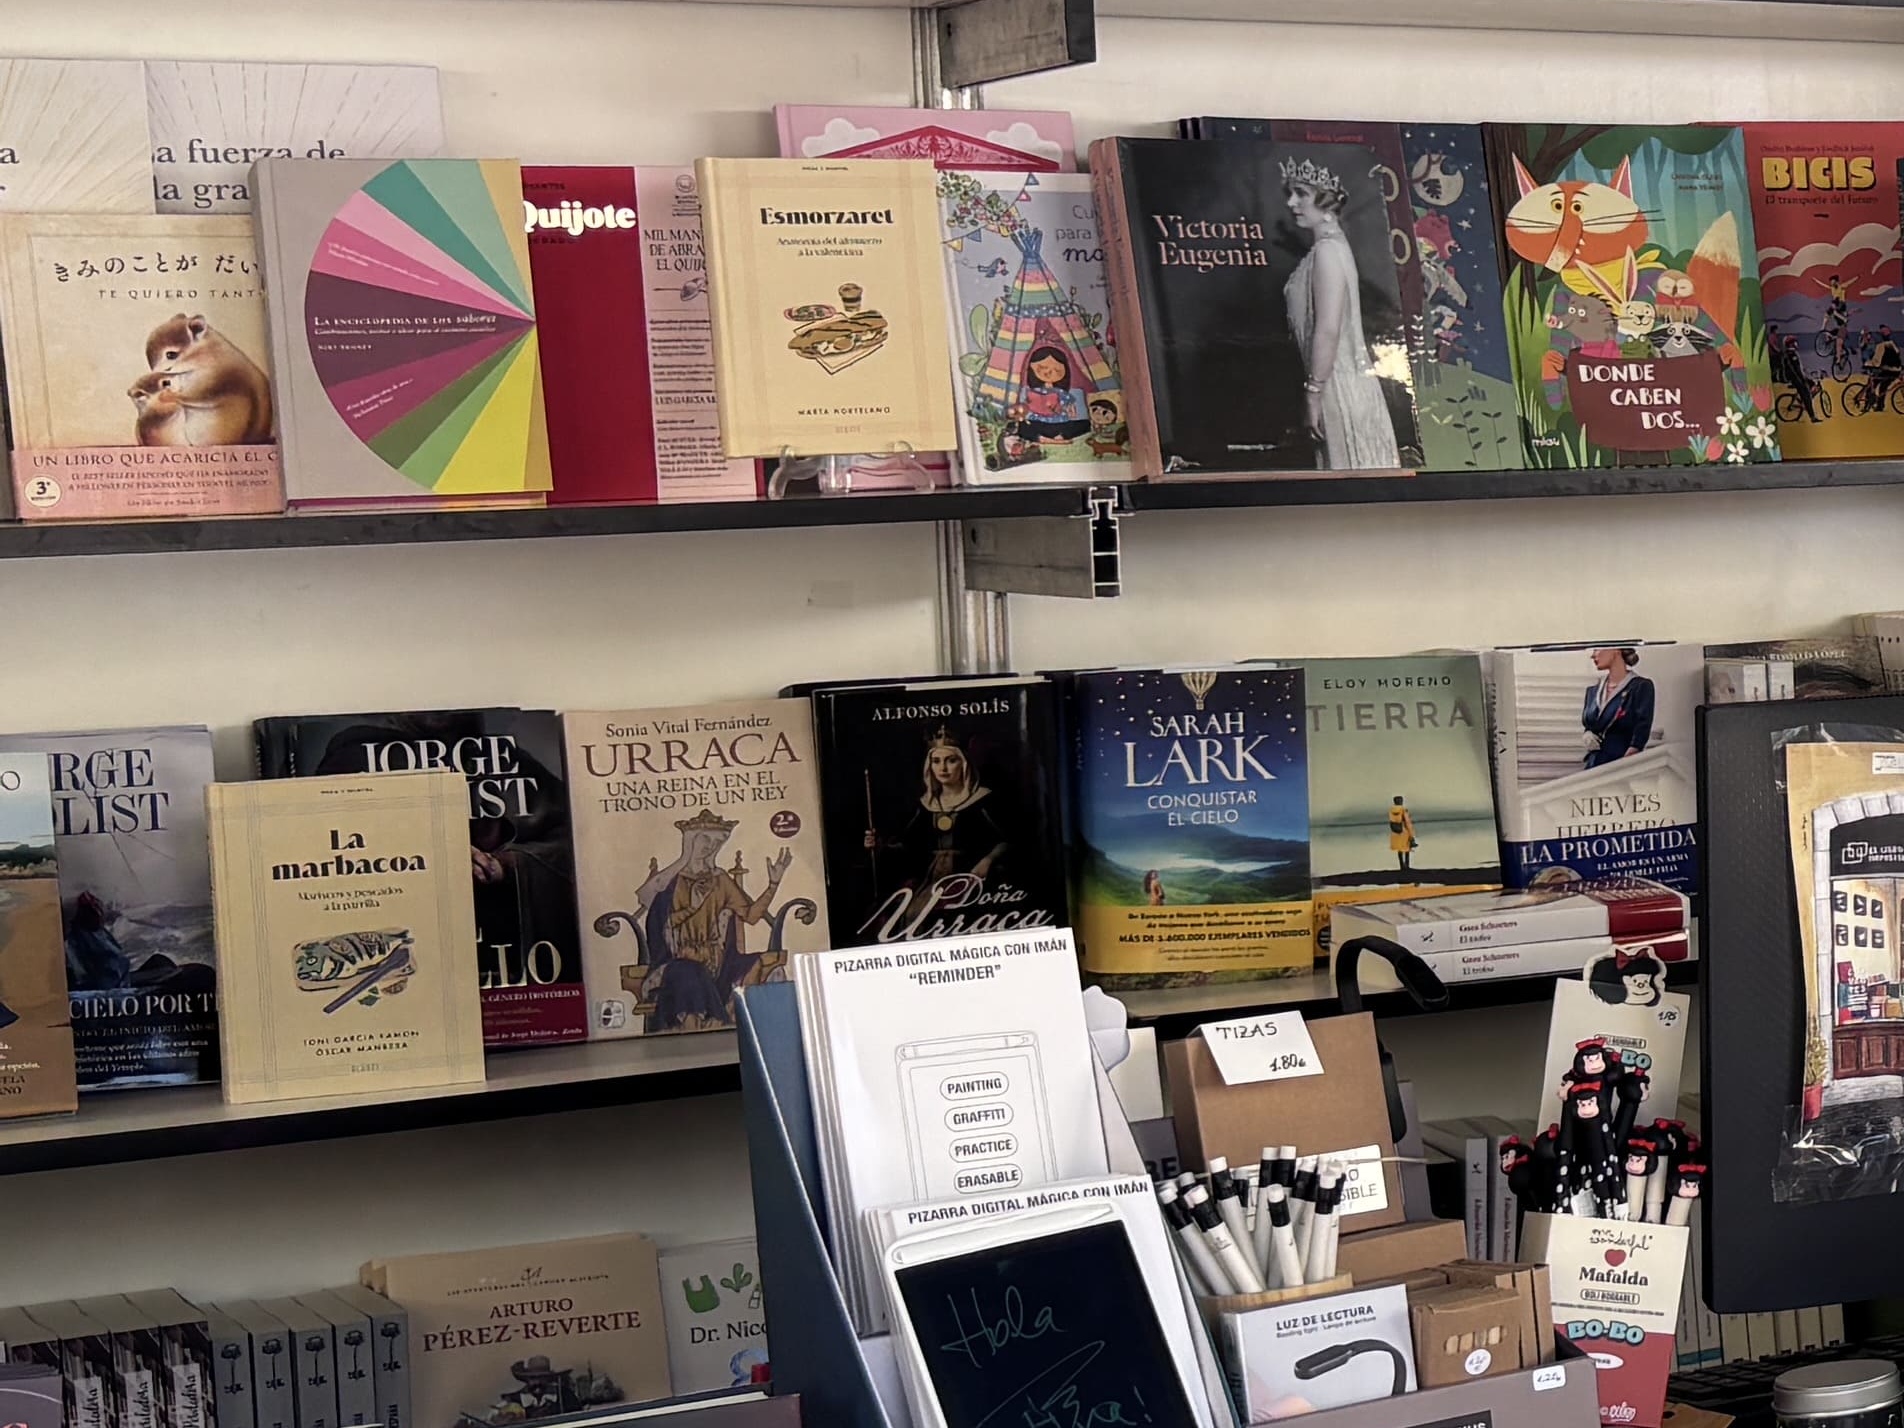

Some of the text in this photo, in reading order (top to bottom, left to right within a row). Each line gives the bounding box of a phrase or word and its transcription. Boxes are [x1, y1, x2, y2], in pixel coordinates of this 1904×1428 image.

[1762, 157, 1876, 191] BICIS
[760, 206, 894, 226] Esmorzaret
[1153, 215, 1264, 240] Victoria
[1159, 240, 1268, 271] Eugenia
[1579, 362, 1655, 384] DONDE
[1610, 386, 1681, 406] CABEN
[1641, 409, 1701, 430] DOS...
[1323, 675, 1452, 690] ELOY MORENO
[871, 698, 1010, 722] ALFONSO SOLÍS
[1308, 702, 1476, 733] TIERRA
[606, 714, 772, 738] Sonia Vital Fernández
[1150, 712, 1245, 739] SARAH
[581, 733, 802, 778] URRACA
[1124, 734, 1279, 788] LARK
[1148, 791, 1257, 810] CONQUISTAR
[1167, 808, 1239, 827] EL CIELO
[329, 830, 365, 851] La
[1520, 827, 1697, 865] LA PROMETIDA
[272, 851, 426, 881] marbacoa
[834, 935, 1067, 974] PIZARRA DIGITAL MÁGICA CON IMÁN
[908, 964, 1003, 986] “REMINDER”
[1216, 1021, 1279, 1040] TIZAS
[947, 1077, 1003, 1095] PAINTING
[952, 1106, 1007, 1125] GRAFFITI
[954, 1138, 1013, 1156] PRACTICE
[957, 1168, 1020, 1189] ERASABLE
[1579, 1267, 1648, 1287] Mafalda
[489, 1297, 573, 1320] ARTURO
[422, 1310, 642, 1353] PÉREZ-REVERTE
